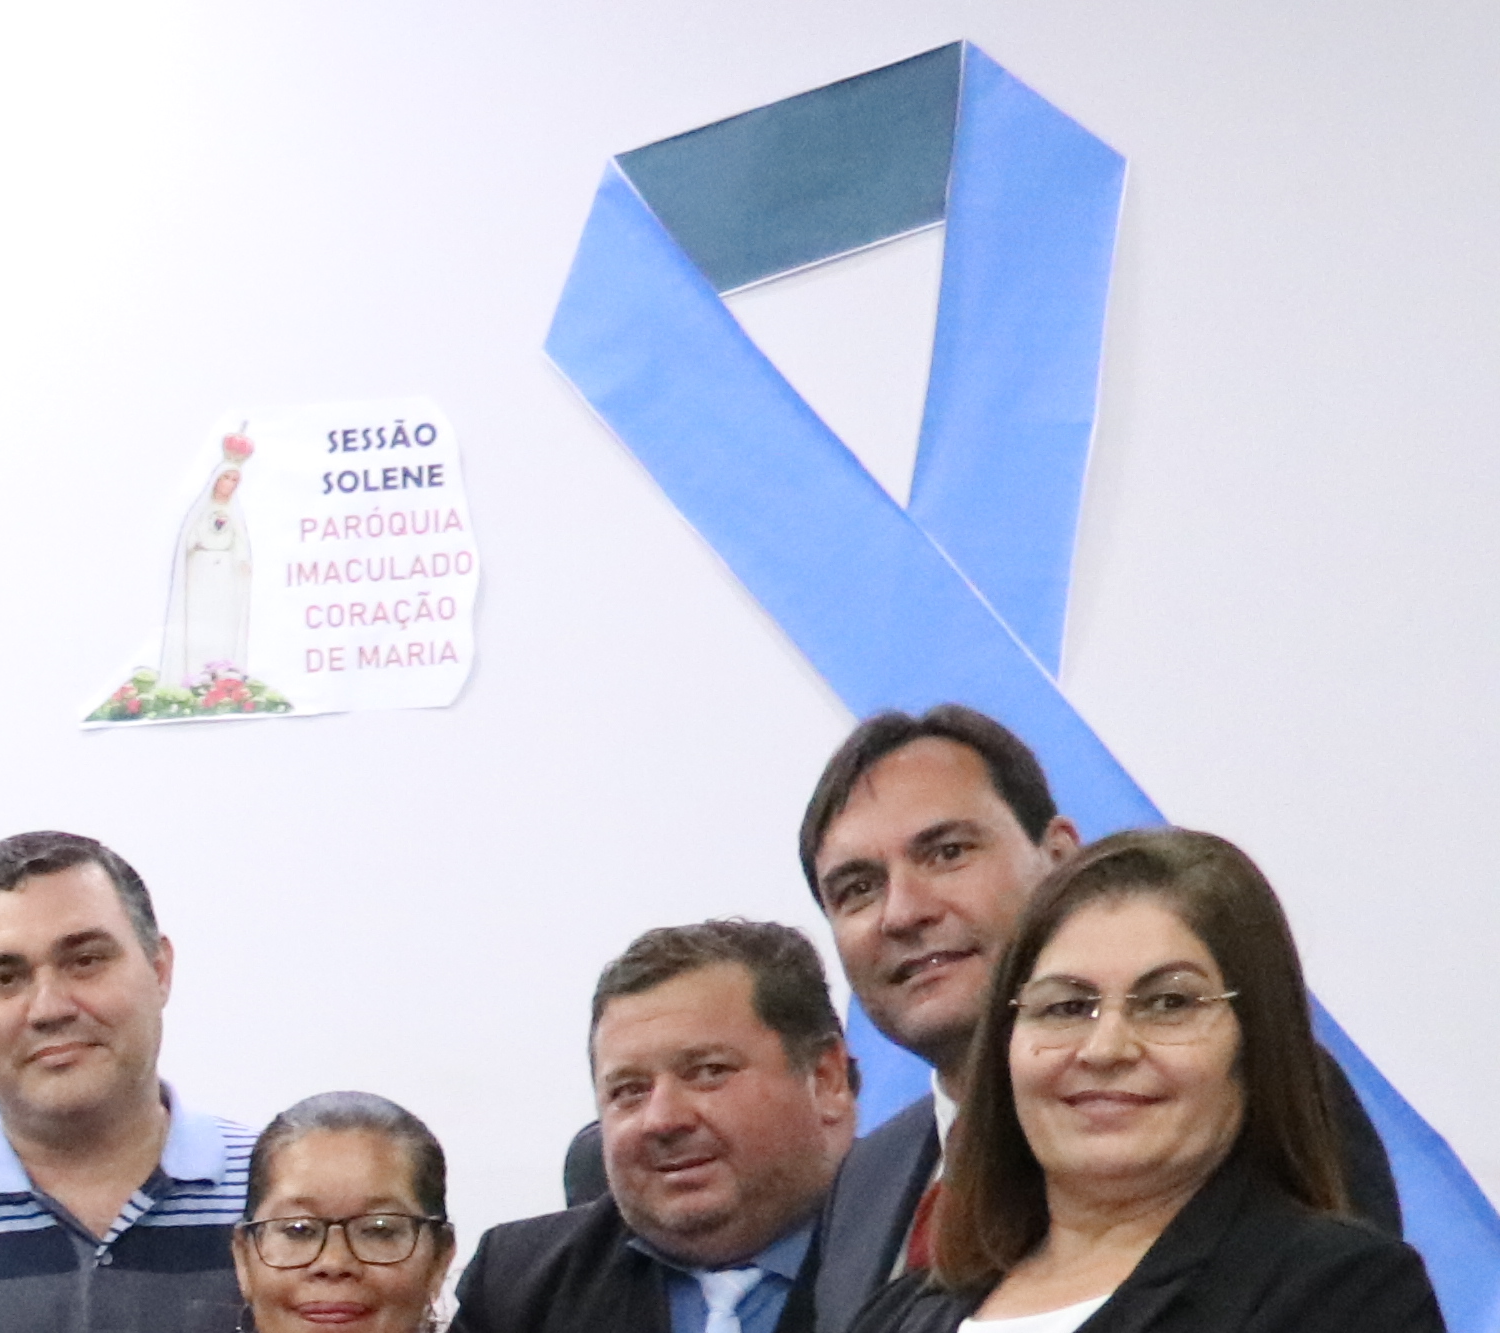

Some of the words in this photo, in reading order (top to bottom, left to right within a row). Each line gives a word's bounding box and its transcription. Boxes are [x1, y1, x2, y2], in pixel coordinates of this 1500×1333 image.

[327, 419, 437, 454] SESSÃO
[322, 463, 445, 495] SOLENE
[300, 506, 463, 543] PARÓQUIA
[286, 551, 473, 587] IMACULADO
[305, 592, 457, 630] CORAÇÃO
[305, 646, 345, 673] DE
[358, 640, 459, 671] MARIA
